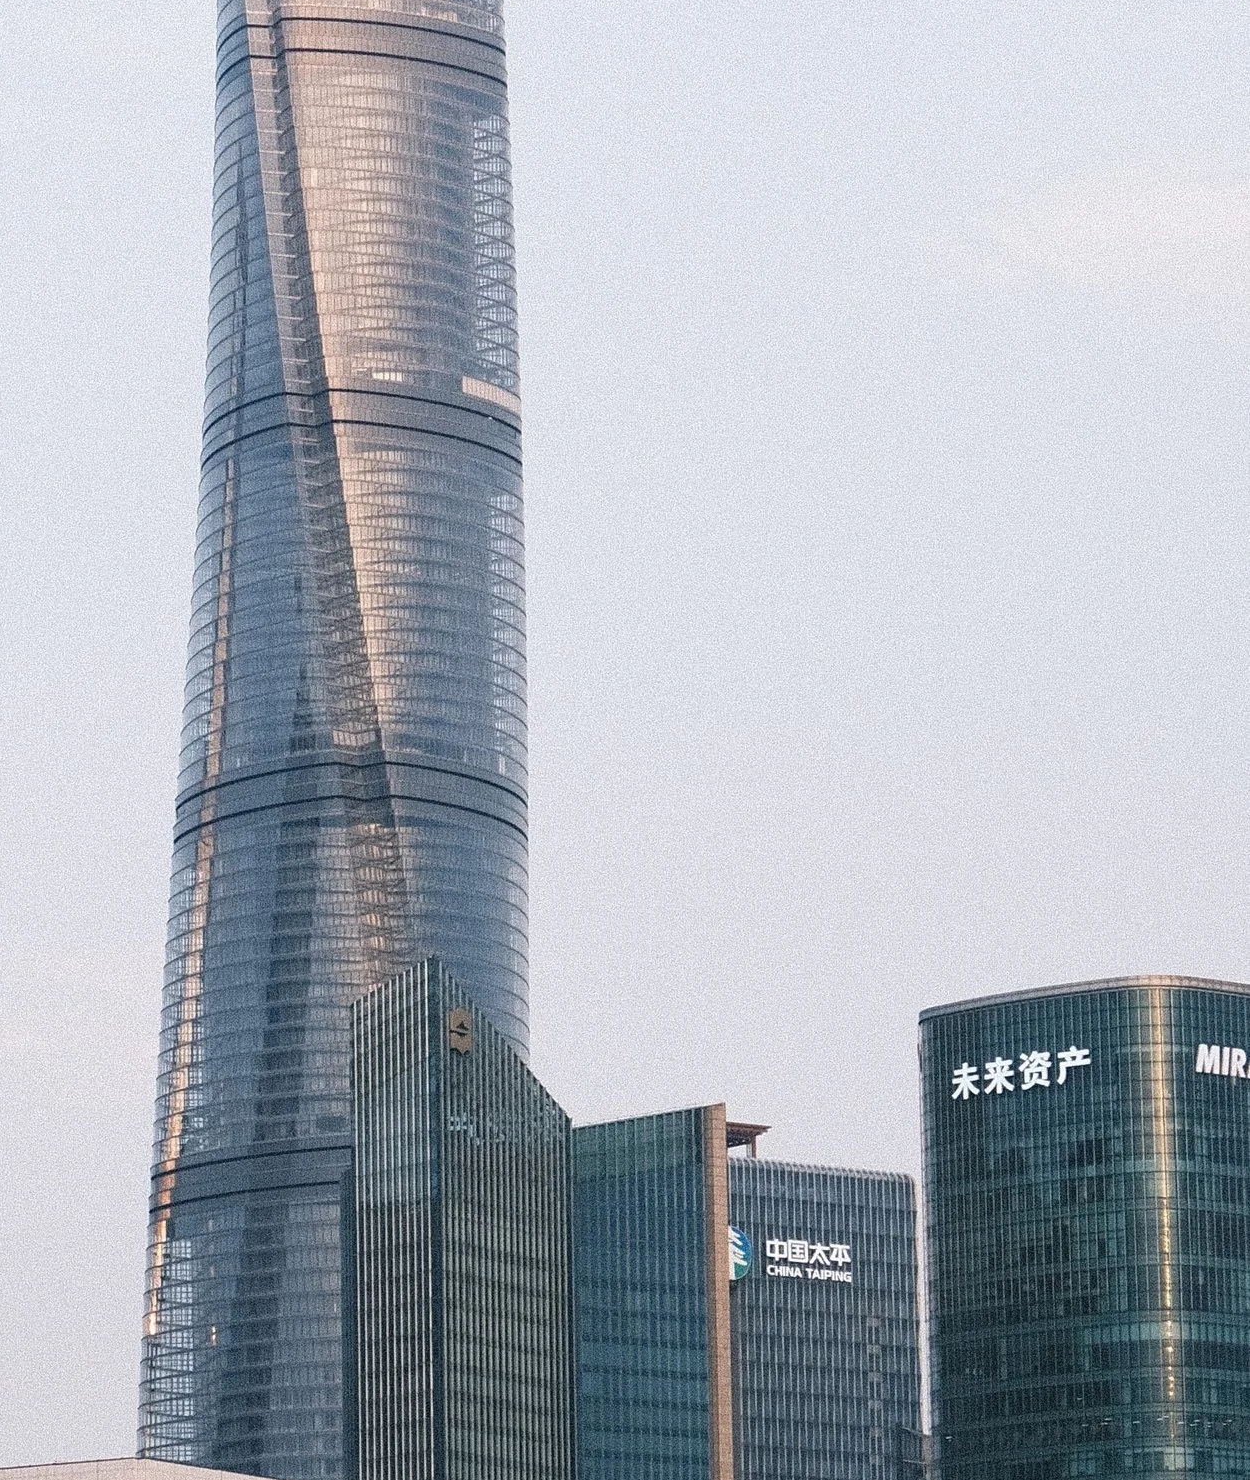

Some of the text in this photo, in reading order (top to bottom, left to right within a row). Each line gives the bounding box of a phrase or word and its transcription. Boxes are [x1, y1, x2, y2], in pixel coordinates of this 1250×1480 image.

[951, 1046, 1092, 1100] 未来资产
[1196, 1043, 1250, 1079] MIR
[765, 1238, 852, 1267] 中国太平
[766, 1264, 853, 1283] CHINA TAIPING
